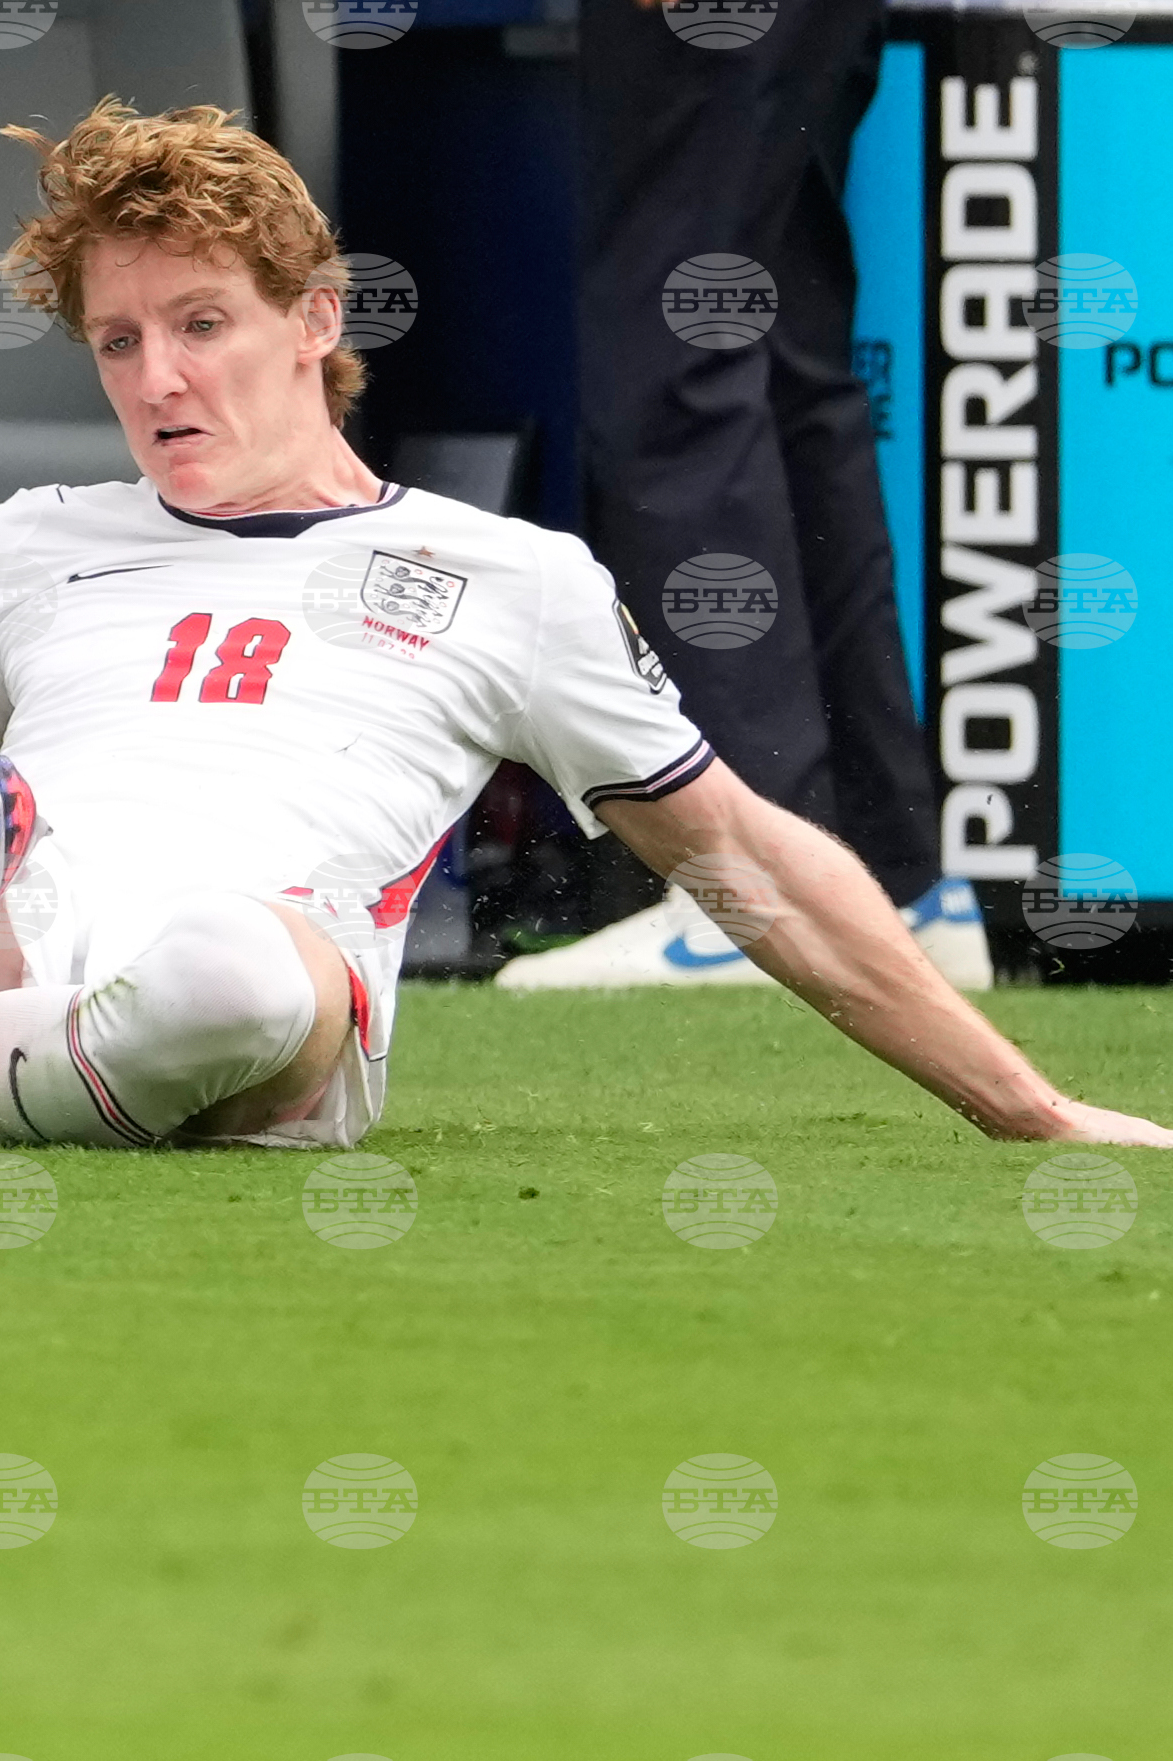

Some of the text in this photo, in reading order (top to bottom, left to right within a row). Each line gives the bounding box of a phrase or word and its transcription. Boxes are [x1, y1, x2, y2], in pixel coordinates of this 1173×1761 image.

[939, 74, 1039, 880] POWERADE
[149, 612, 291, 705] 18
[361, 615, 430, 652] NORWAY
